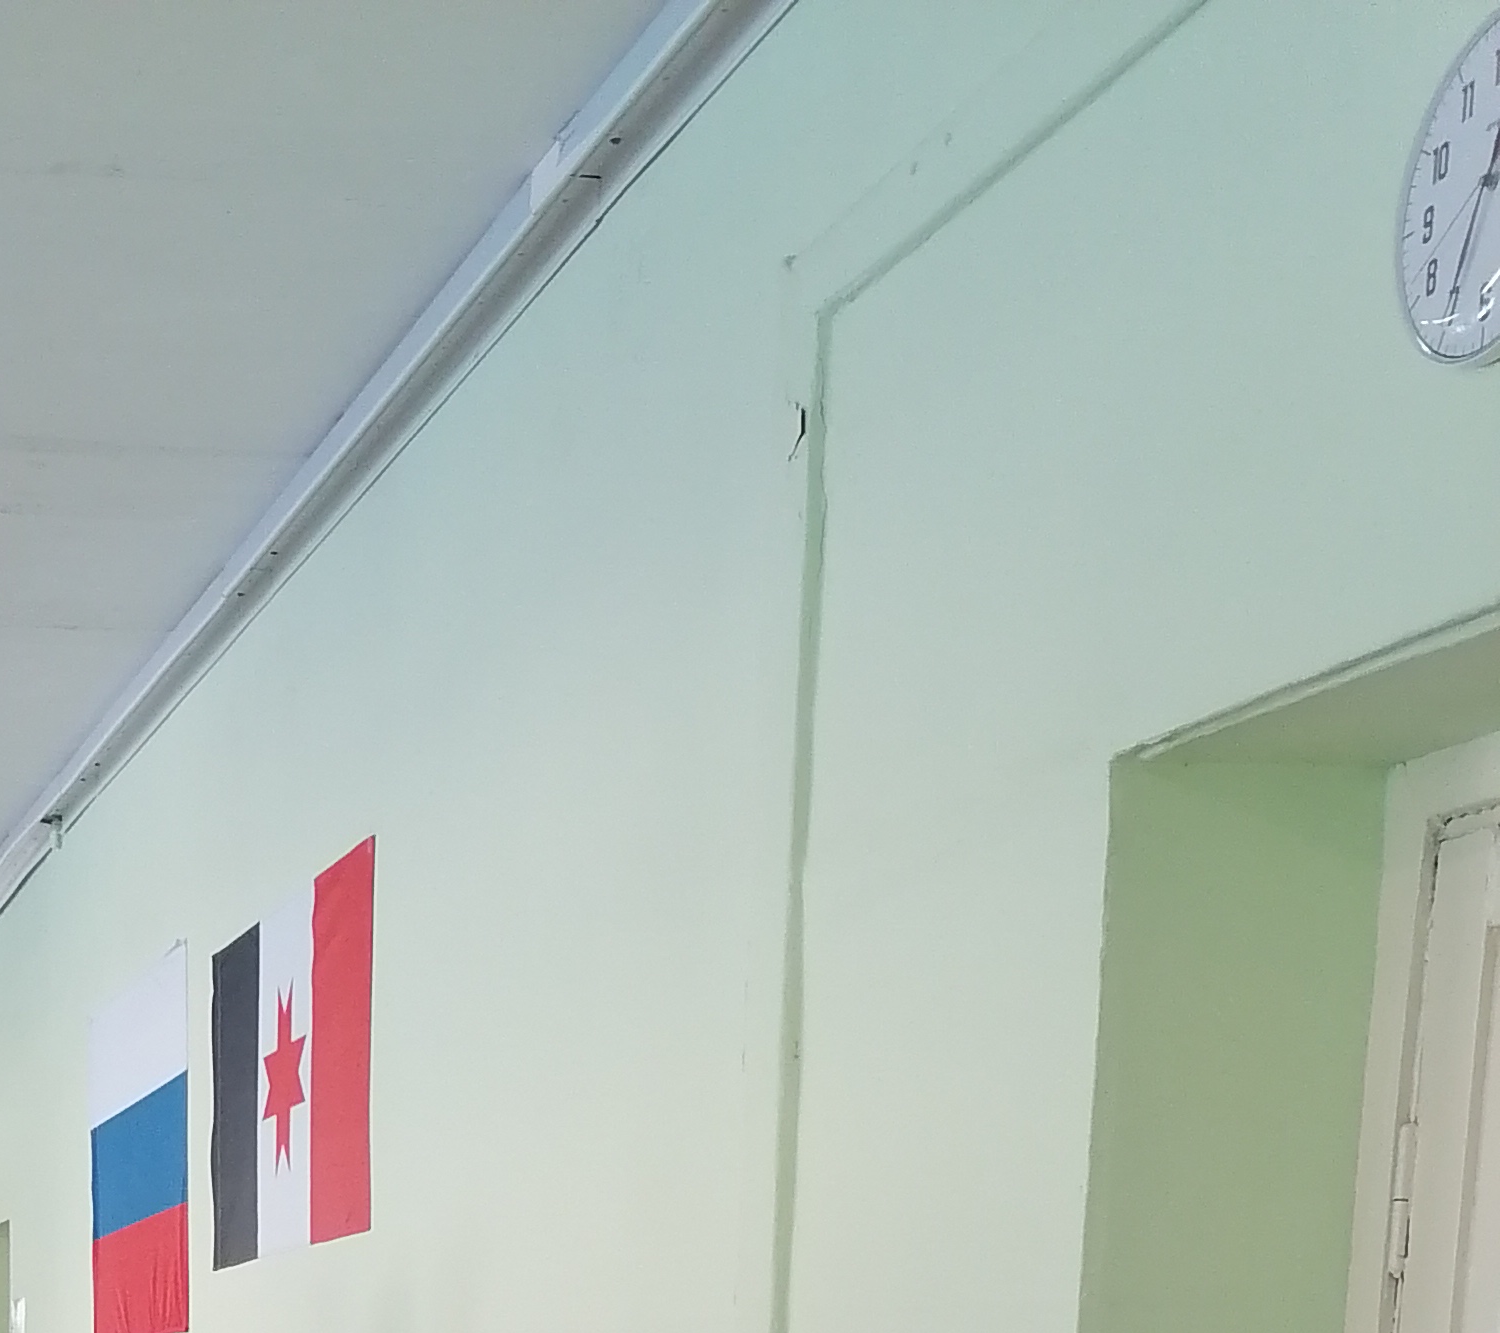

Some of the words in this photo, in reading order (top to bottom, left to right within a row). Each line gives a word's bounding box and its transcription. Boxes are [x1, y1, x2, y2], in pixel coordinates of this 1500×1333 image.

[1461, 79, 1476, 123] 11
[1432, 141, 1450, 186] 10
[1422, 205, 1435, 244] 9
[1425, 258, 1439, 297] 8
